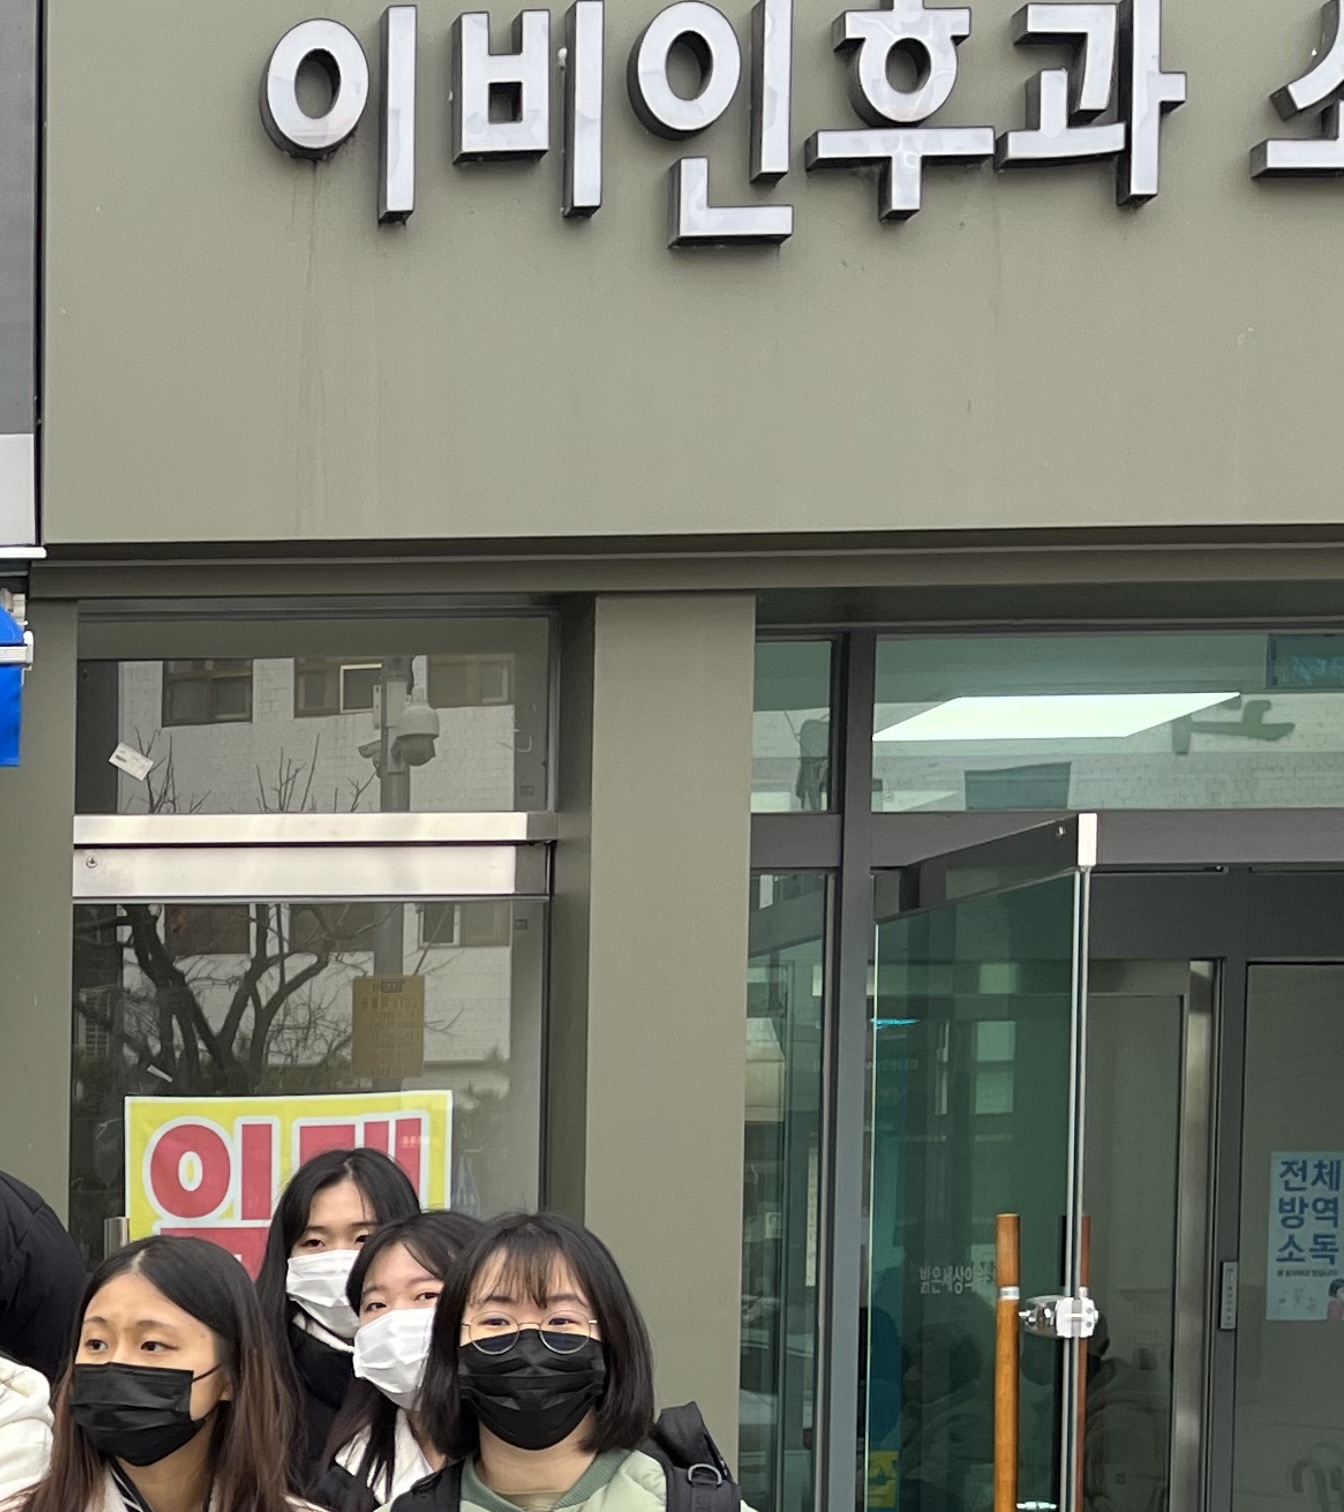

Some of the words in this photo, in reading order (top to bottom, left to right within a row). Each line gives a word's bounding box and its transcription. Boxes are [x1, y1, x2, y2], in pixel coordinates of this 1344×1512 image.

[260, 0, 1188, 248] 이비인후과
[1278, 1158, 1342, 1192] 전체
[1277, 1196, 1340, 1230] 방역
[1275, 1233, 1340, 1266] 소독
